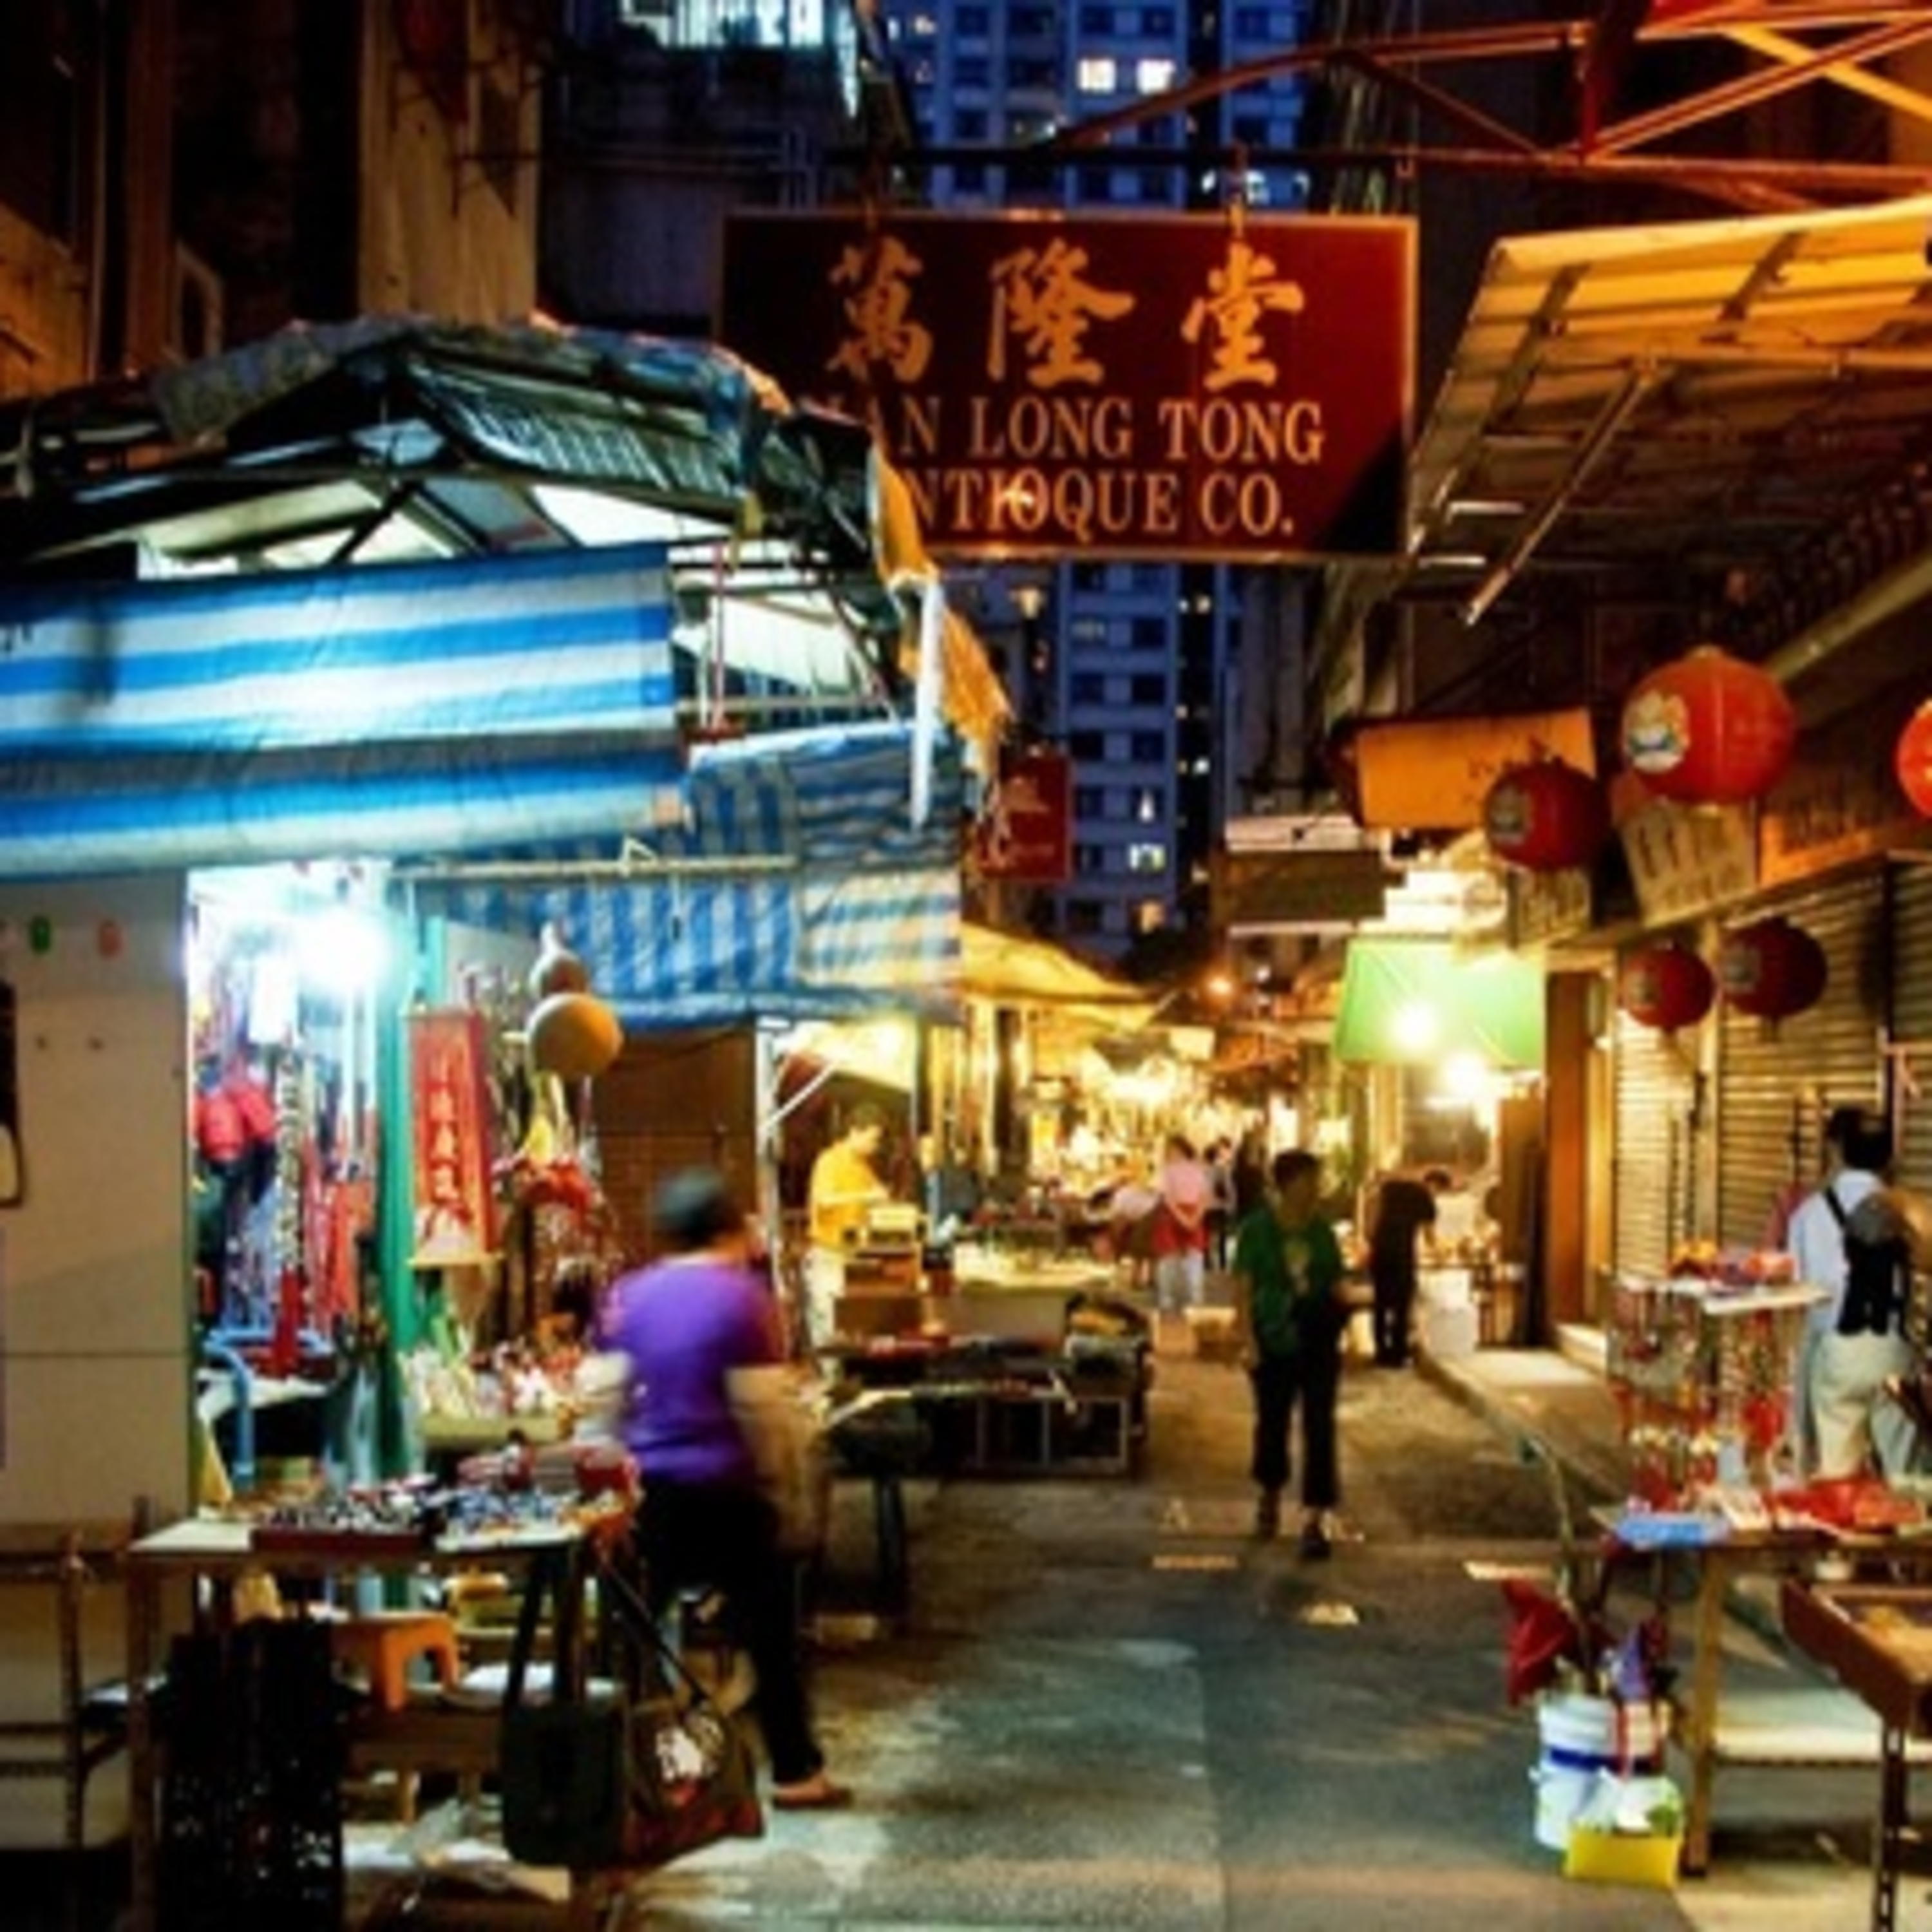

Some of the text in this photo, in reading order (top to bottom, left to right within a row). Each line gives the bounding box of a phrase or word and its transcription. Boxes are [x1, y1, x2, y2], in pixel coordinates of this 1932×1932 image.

[826, 236, 1305, 390] 萬隆堂
[970, 395, 1133, 460] LONG
[1160, 398, 1325, 464] TONG
[903, 466, 1294, 544] NTIOQUE CO.
